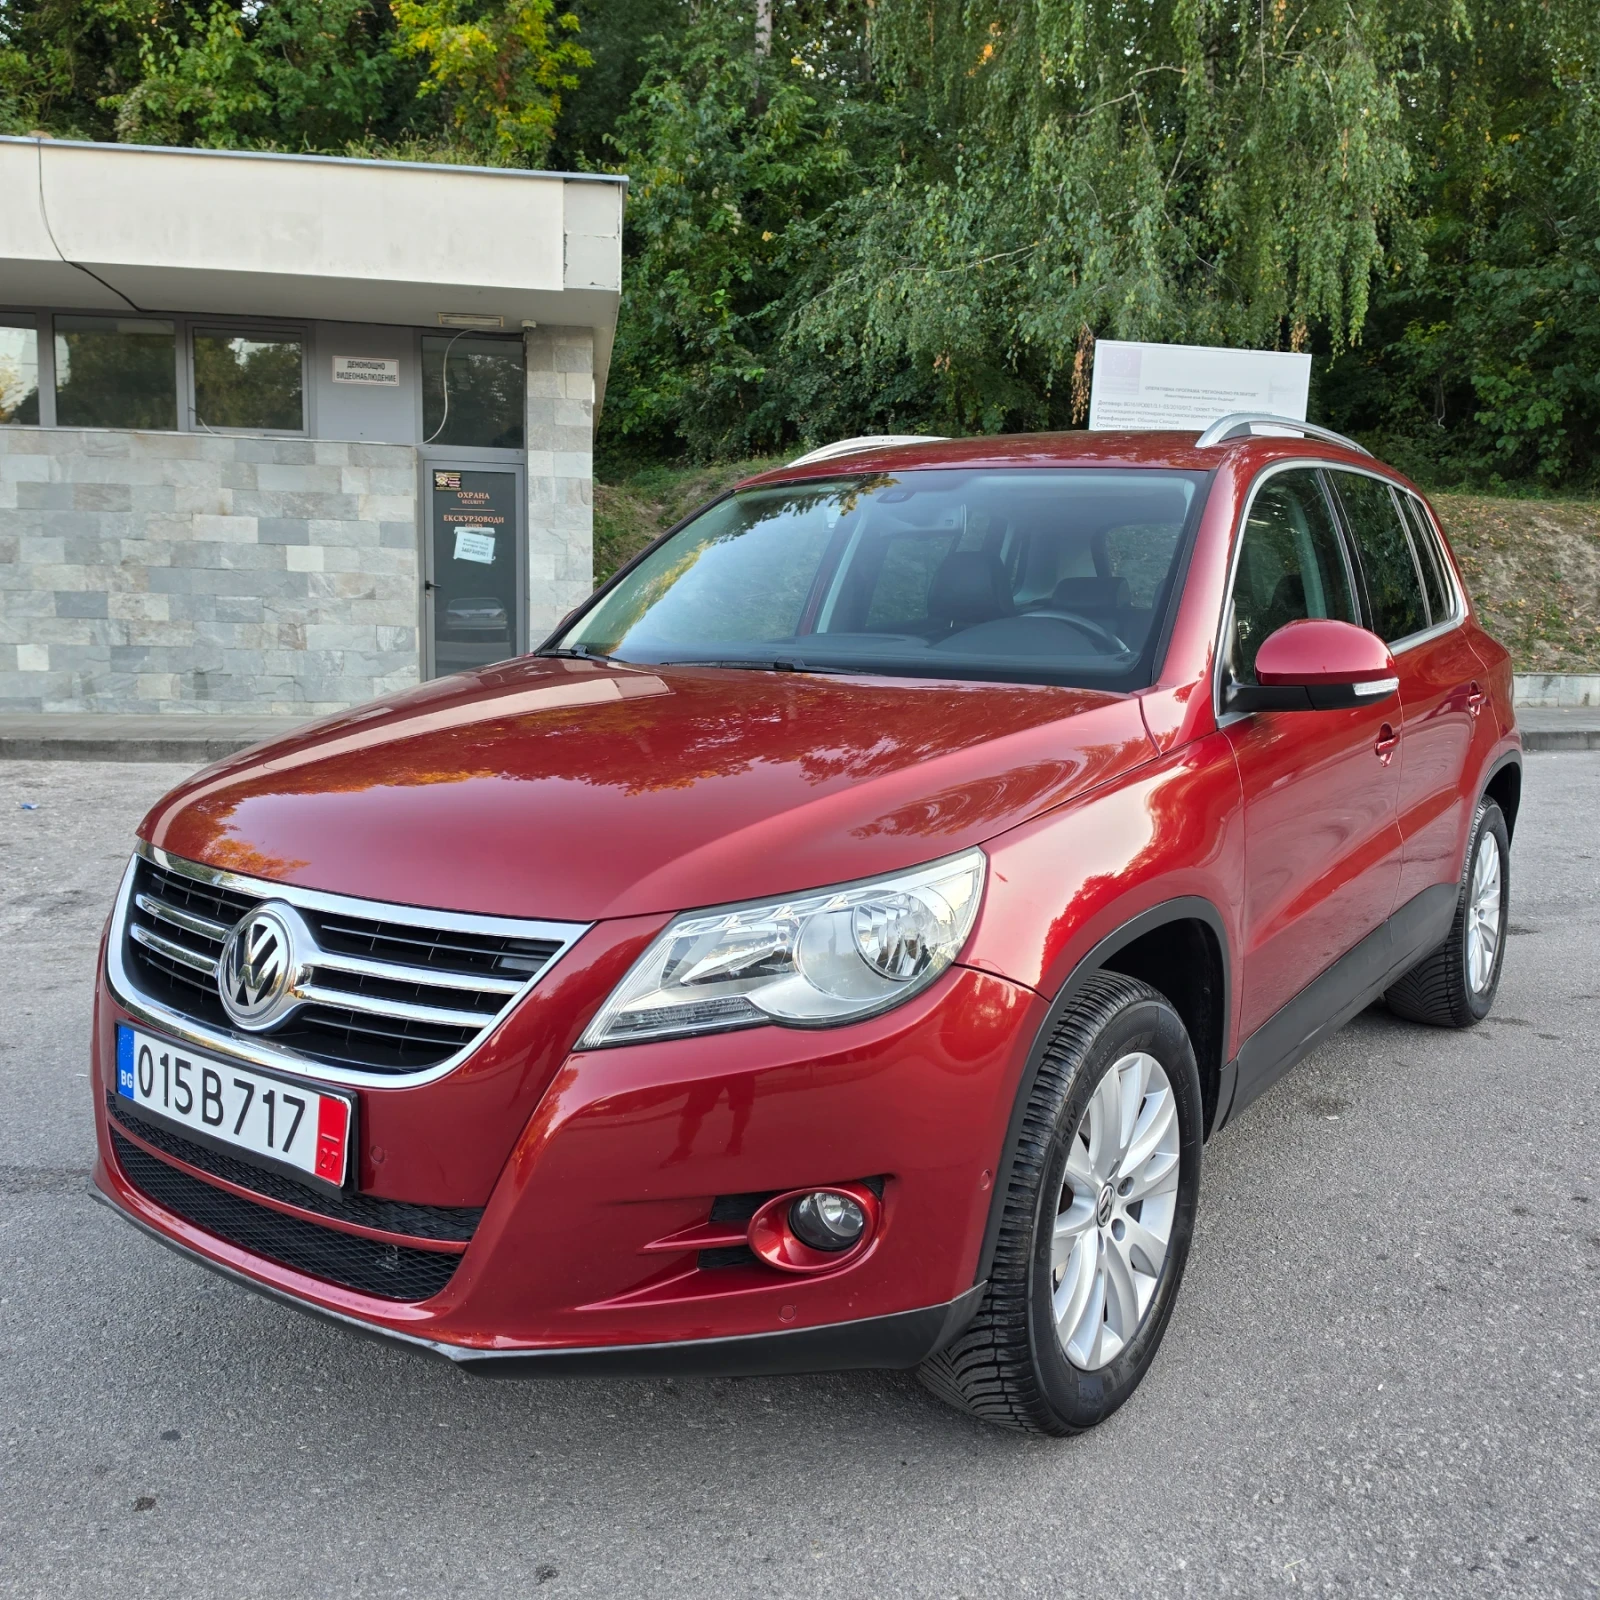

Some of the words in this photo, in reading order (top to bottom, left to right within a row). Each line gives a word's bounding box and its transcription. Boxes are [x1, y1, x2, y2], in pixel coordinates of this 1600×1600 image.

[347, 360, 386, 370] ДЕНОНОЩНО
[336, 371, 397, 382] ВИДЕОНАБЛЮДЕНИЕ
[457, 491, 490, 500] ОХРАНА
[443, 514, 505, 524] ЕКСКУРЗОВОДИ
[120, 1069, 133, 1088] BG
[138, 1044, 306, 1153] 015B717
[1060, 1104, 1079, 1148] SUV
